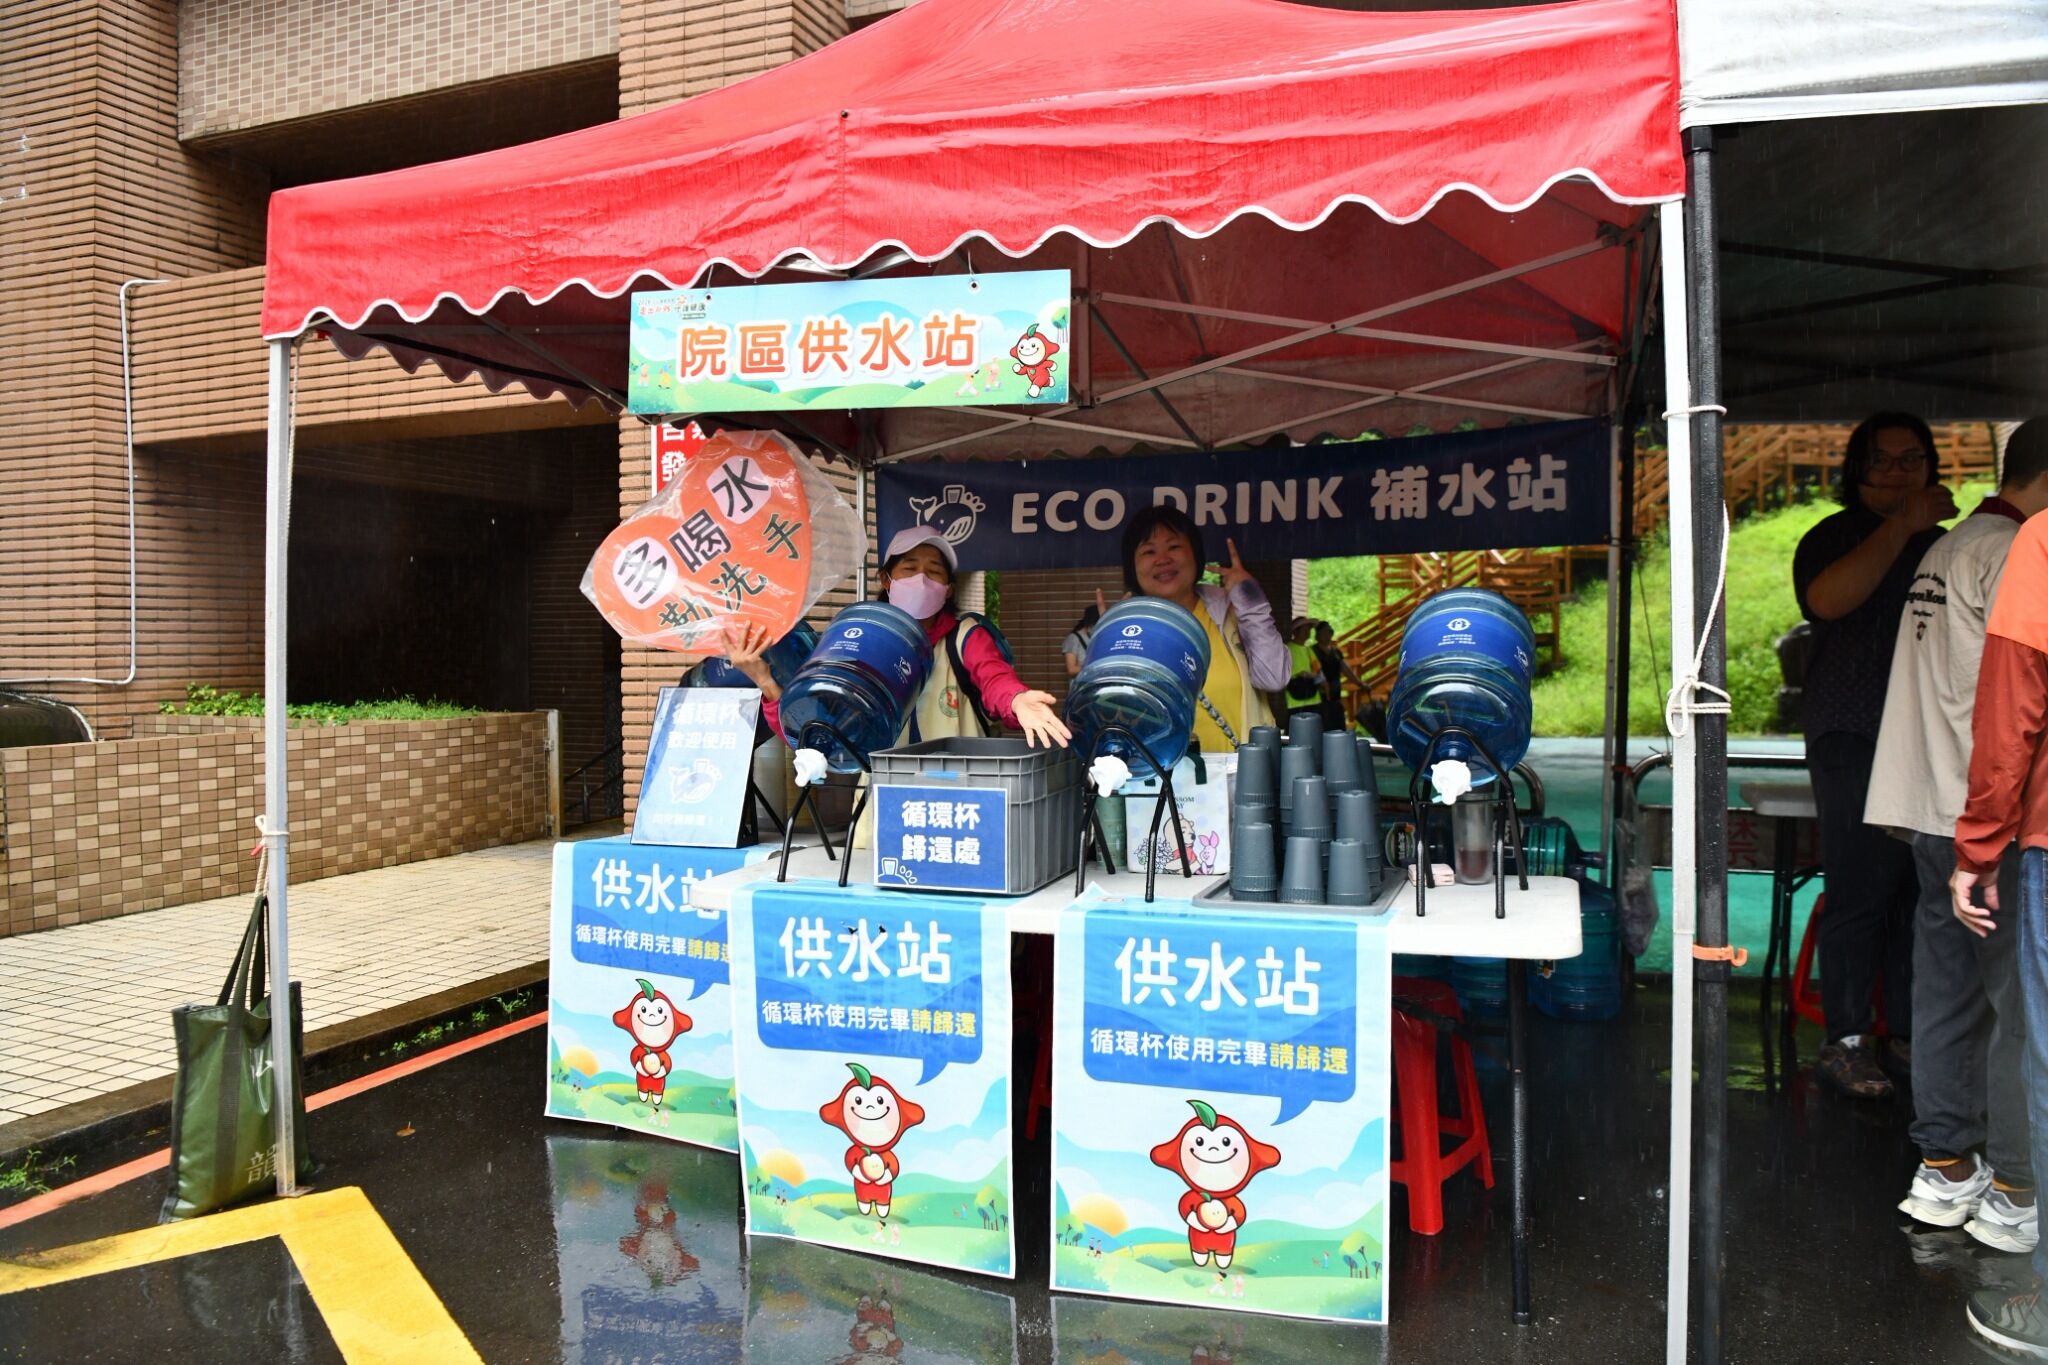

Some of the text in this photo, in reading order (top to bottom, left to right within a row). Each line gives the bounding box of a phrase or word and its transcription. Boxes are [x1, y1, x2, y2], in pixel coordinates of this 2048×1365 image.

[679, 313, 977, 379] 院區供水站
[1011, 488, 1126, 534] ECO
[1370, 454, 1567, 520] 補水站
[618, 458, 769, 605] 多喝水
[901, 800, 980, 830] 循環杯
[901, 833, 980, 865] 歸還處
[779, 917, 952, 984] 供水站
[1114, 937, 1322, 1016] 供水站
[762, 1000, 977, 1038] 循環杯使用完畢請歸還
[1090, 1027, 1349, 1075] 循環杯使用完畢請歸還
